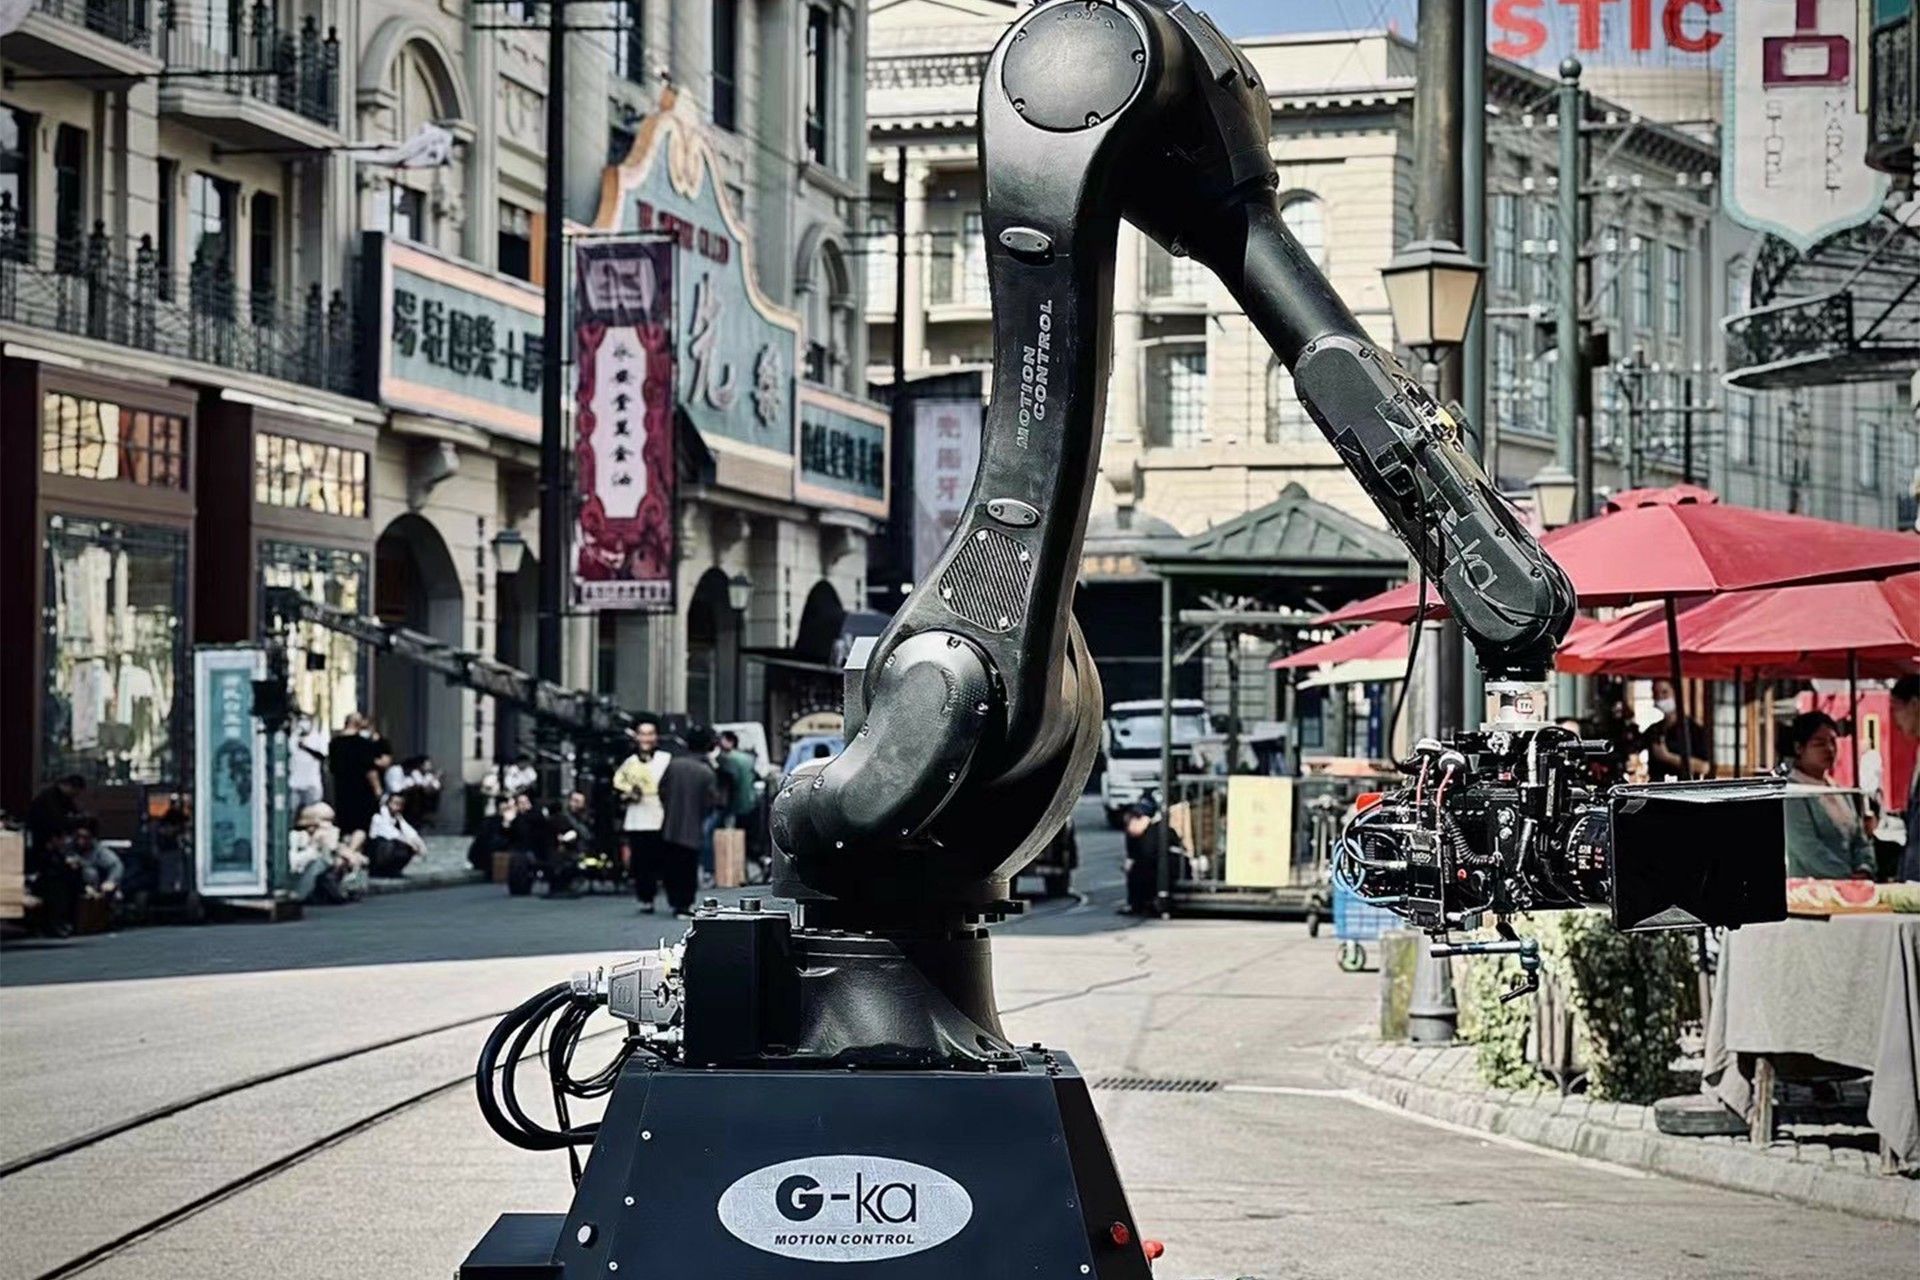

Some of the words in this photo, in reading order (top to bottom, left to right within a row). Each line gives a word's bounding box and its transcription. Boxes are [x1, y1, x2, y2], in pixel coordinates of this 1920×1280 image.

[1765, 100, 1784, 188] STORE
[1825, 99, 1846, 204] MARKET
[1016, 346, 1036, 449] MOTION
[1034, 299, 1053, 421] CONTROL
[774, 1234, 837, 1245] MOTION
[841, 1234, 915, 1245] CONTROL
[775, 1172, 917, 1223] G-ka
